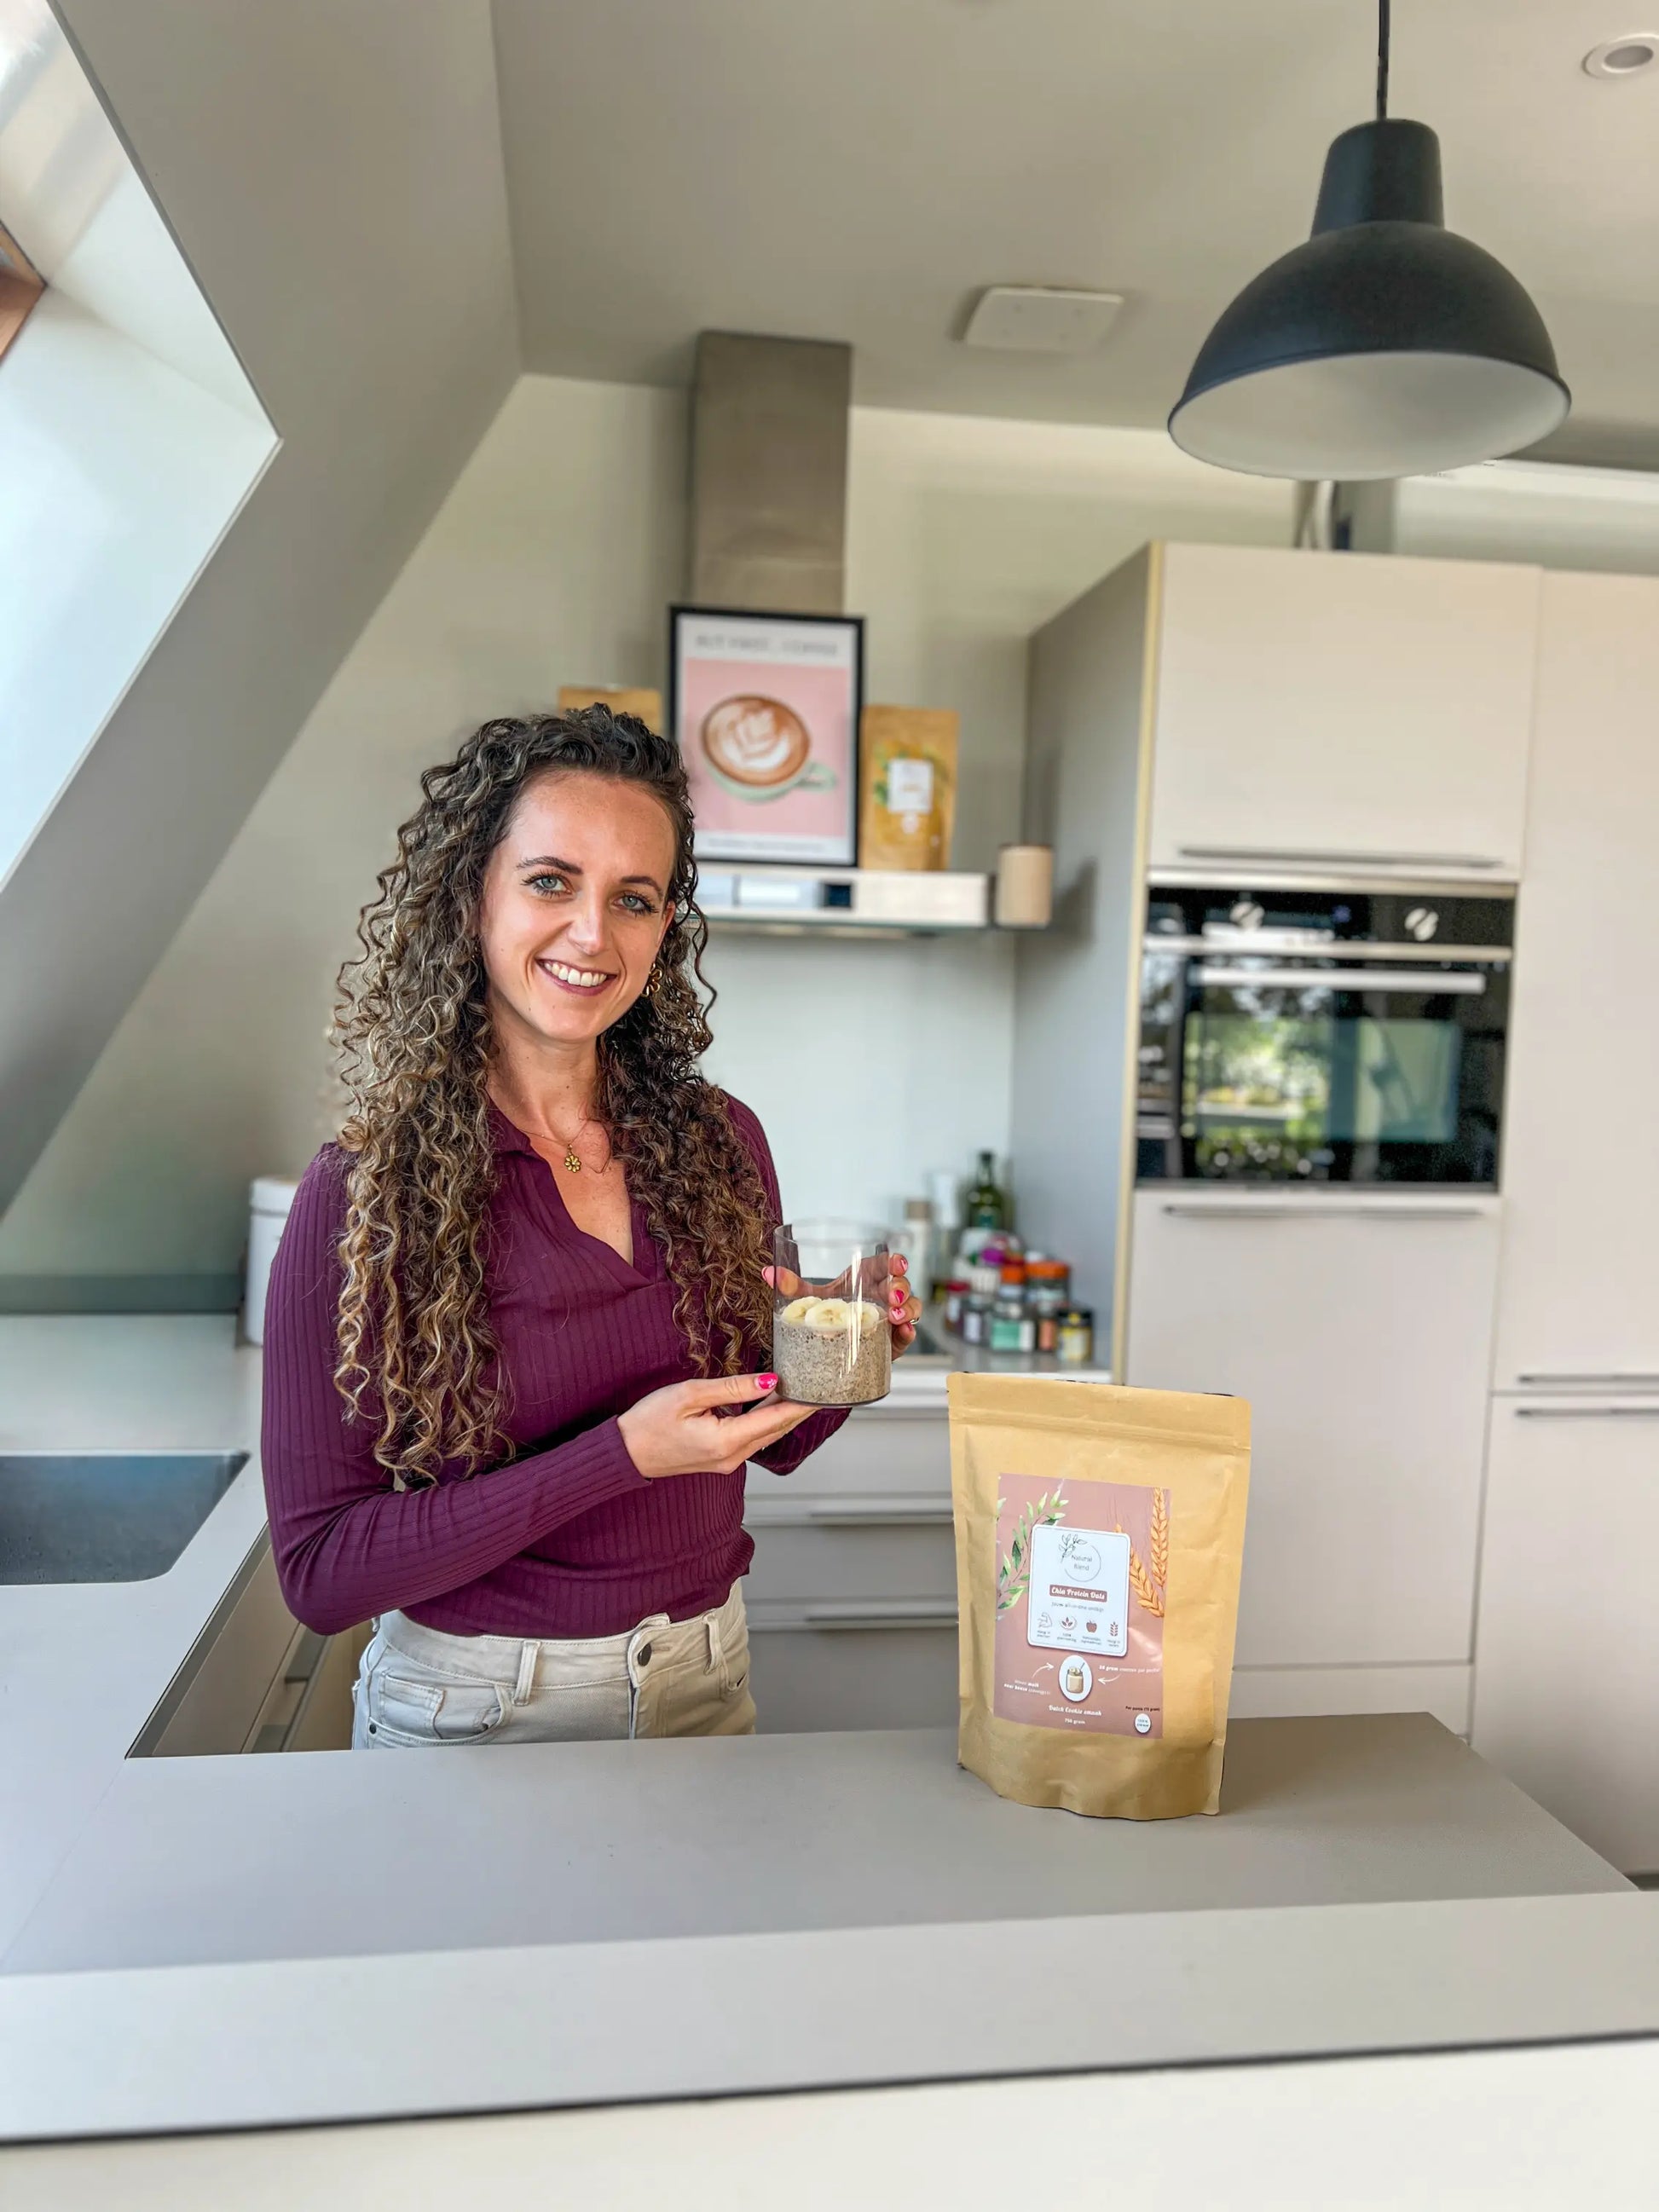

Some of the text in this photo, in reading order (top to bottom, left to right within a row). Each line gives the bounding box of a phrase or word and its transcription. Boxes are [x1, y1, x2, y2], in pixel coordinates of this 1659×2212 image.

[1071, 1554, 1093, 1562] Natural
[1051, 1586, 1106, 1600] Chia Protein Oats
